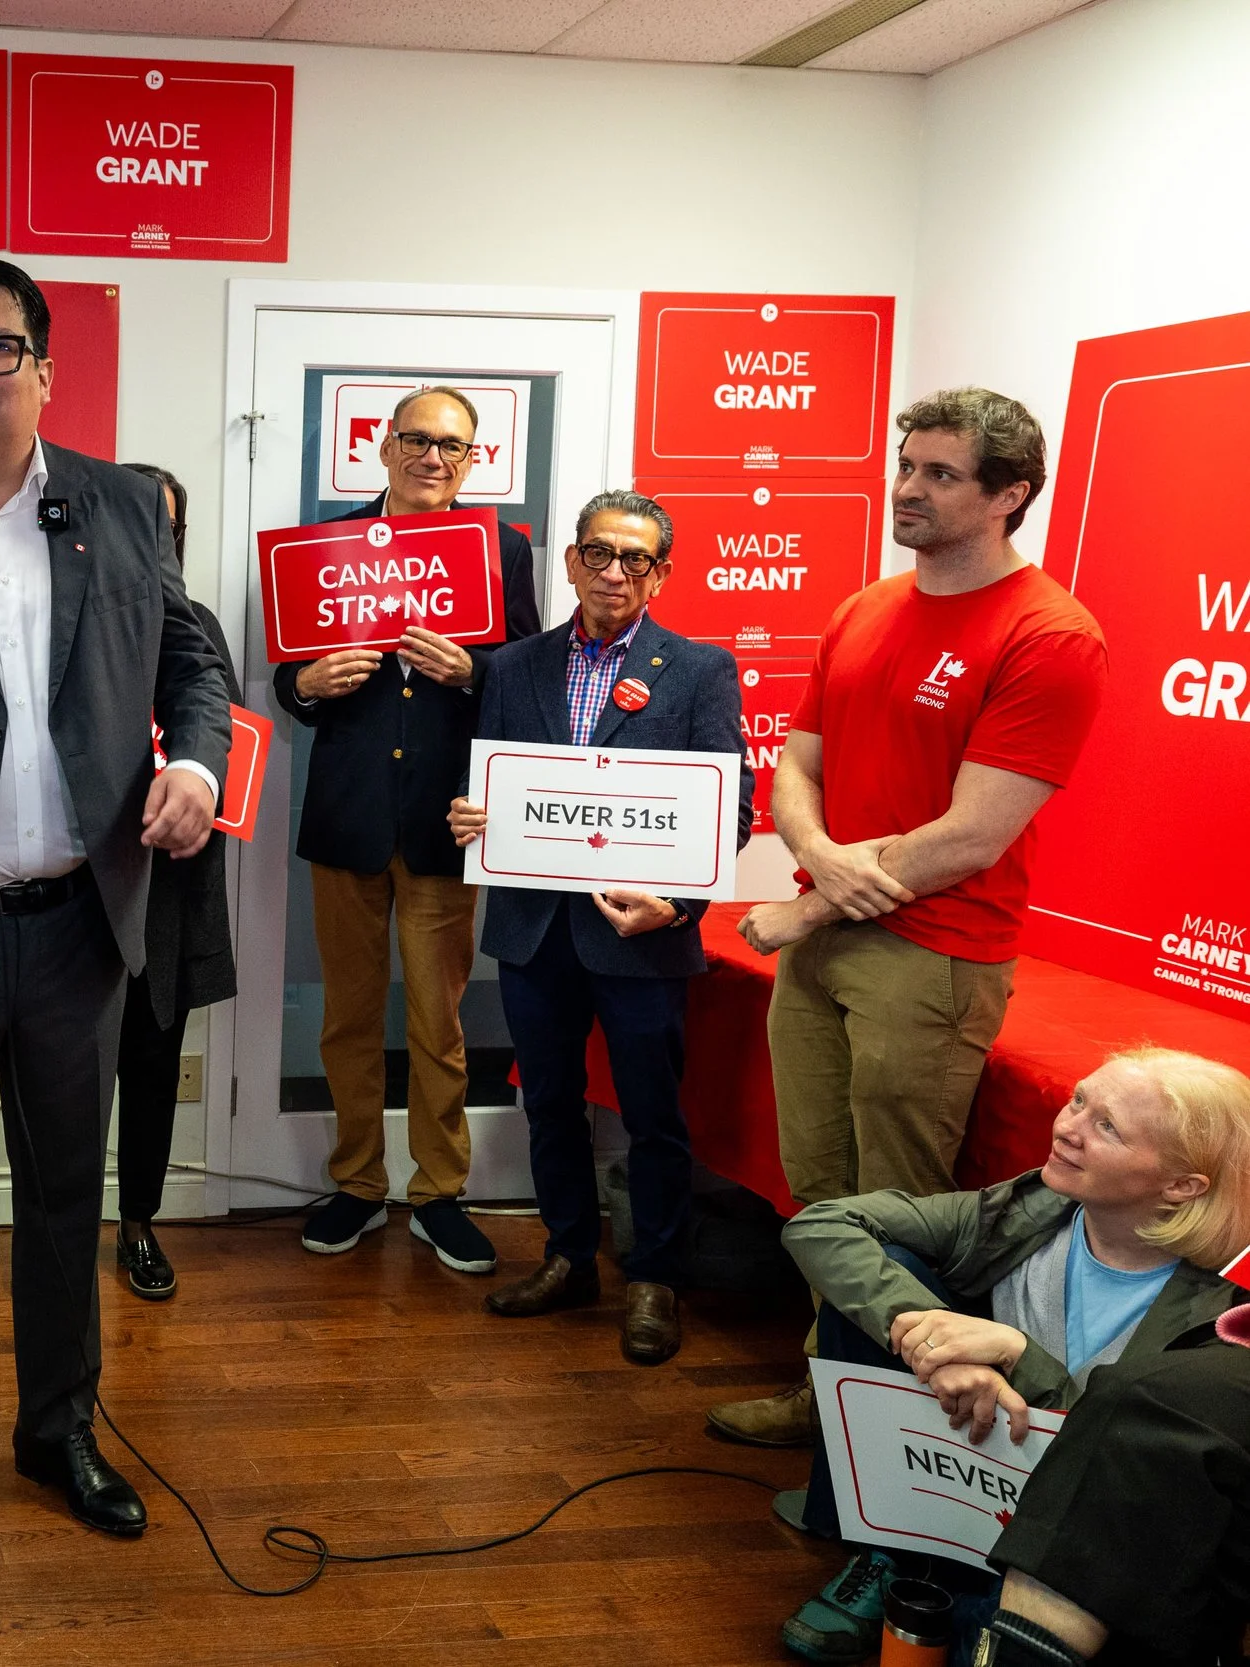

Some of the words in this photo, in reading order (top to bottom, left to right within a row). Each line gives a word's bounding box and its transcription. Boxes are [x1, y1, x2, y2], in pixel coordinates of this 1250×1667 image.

[105, 119, 200, 150] WADE
[96, 157, 208, 187] GRANT
[131, 232, 170, 241] CARNEY
[138, 224, 163, 232] MARK
[724, 350, 810, 376] WADE
[713, 384, 817, 410] GRANT
[743, 453, 779, 461] CARNEY
[716, 533, 802, 558] WADE
[318, 555, 449, 589] CANADA
[706, 566, 808, 591] GRANT
[913, 694, 945, 709] STRONG
[918, 684, 949, 699] CANADA
[740, 713, 790, 737] ADE
[525, 801, 613, 828] NEVER
[621, 808, 678, 831] 51st
[1181, 913, 1247, 948] MARK
[1153, 967, 1200, 989] CANADA
[903, 1444, 1019, 1506] NEVER
